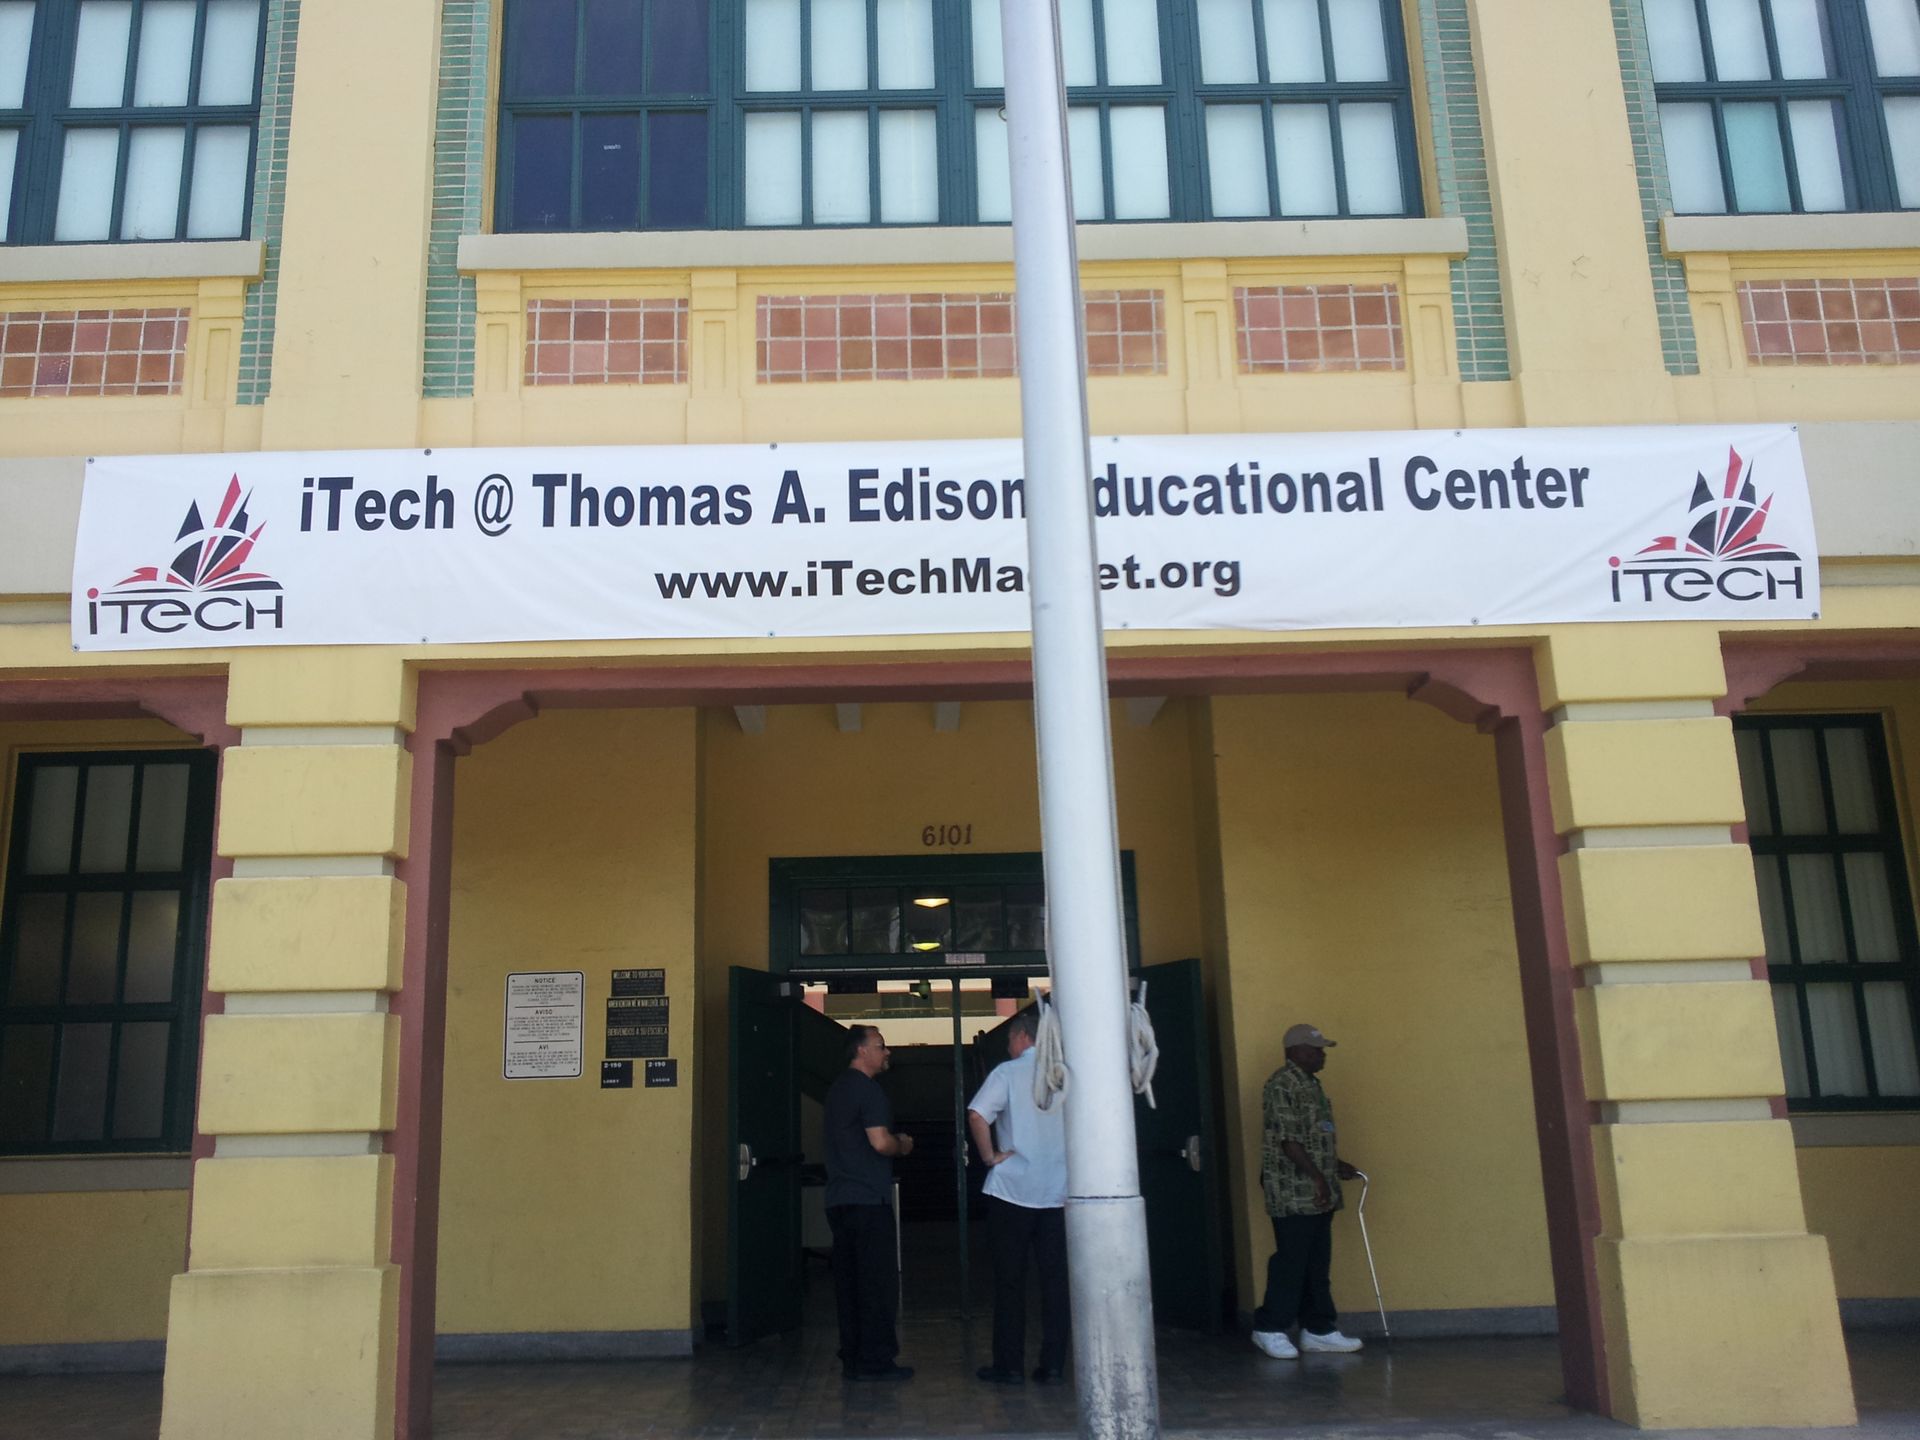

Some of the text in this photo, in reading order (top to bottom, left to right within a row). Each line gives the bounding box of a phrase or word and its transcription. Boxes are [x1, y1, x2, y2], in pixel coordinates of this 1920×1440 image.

[301, 455, 1590, 537] iTech @ Thomas A. Edison ducational Center
[655, 554, 1241, 599] www.iTechMaet.org
[922, 824, 972, 847] 6101
